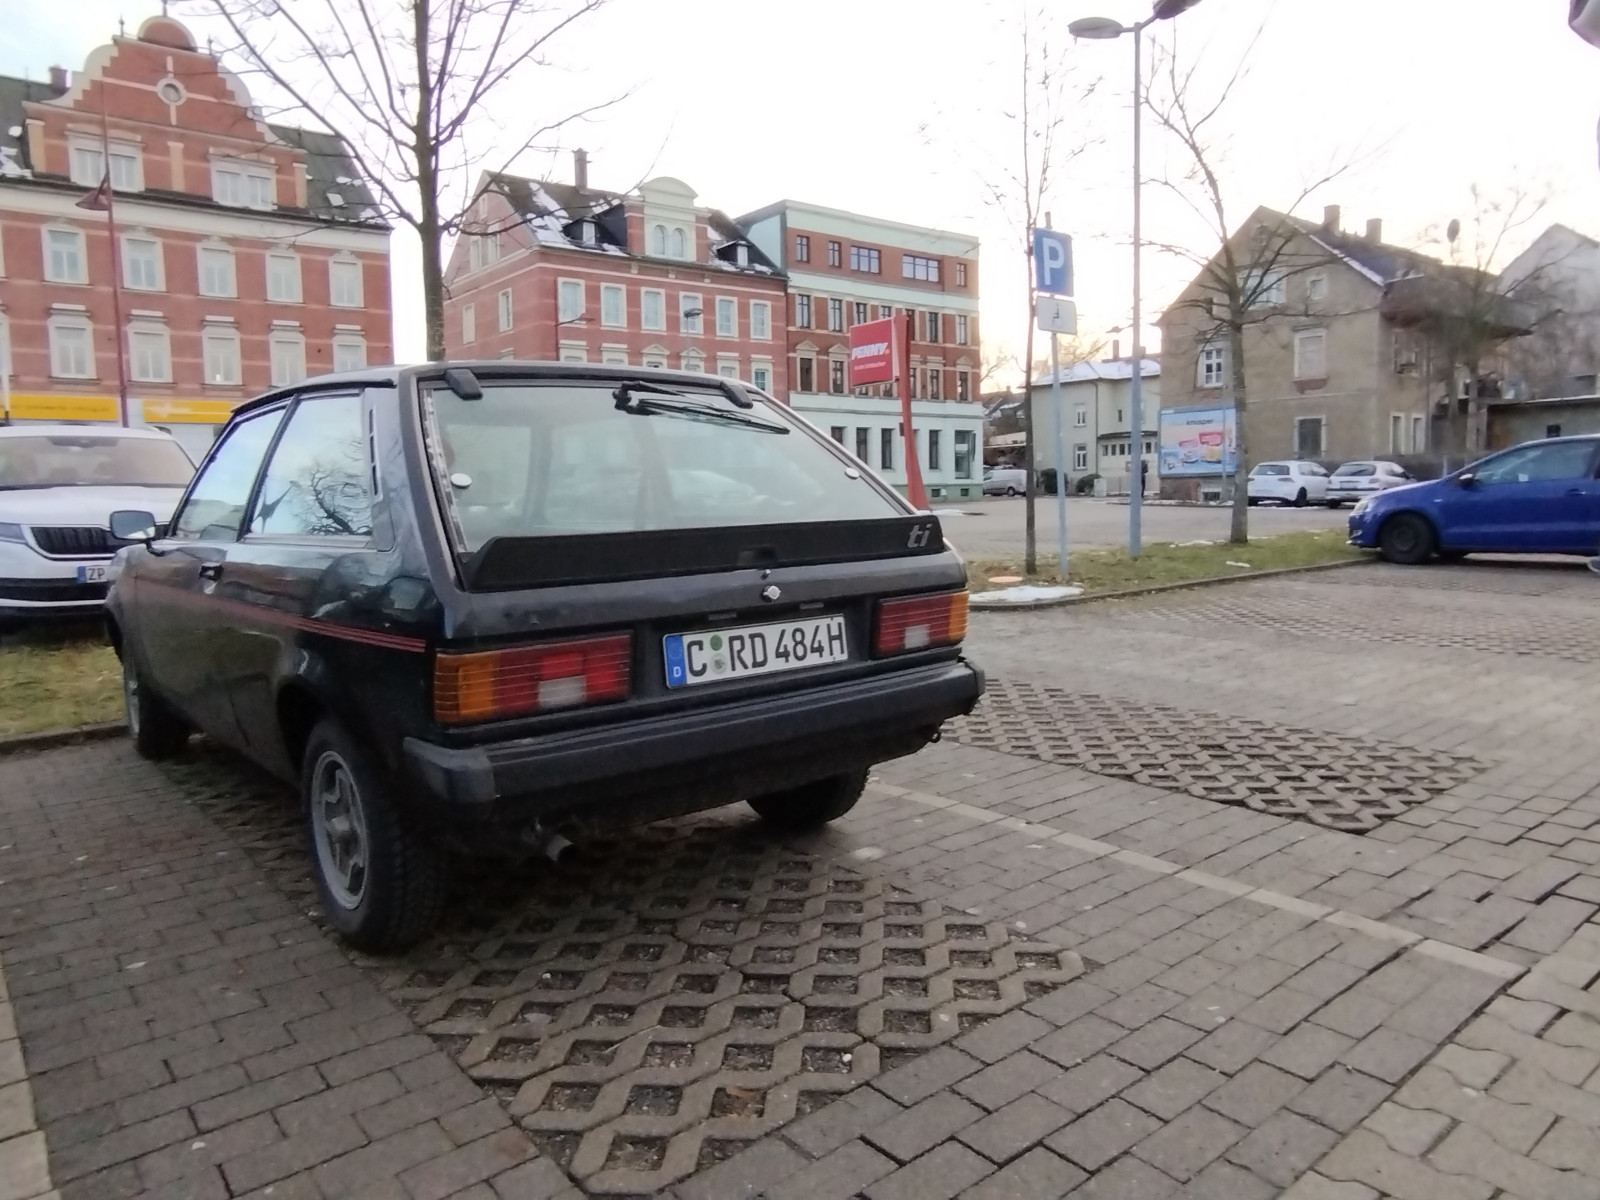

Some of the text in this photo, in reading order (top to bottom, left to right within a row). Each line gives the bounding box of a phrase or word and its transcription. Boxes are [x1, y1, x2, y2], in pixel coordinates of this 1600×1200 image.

[1042, 237, 1065, 285] P
[907, 523, 933, 548] ti
[687, 622, 845, 677] C RD 484H
[672, 666, 682, 678] D
